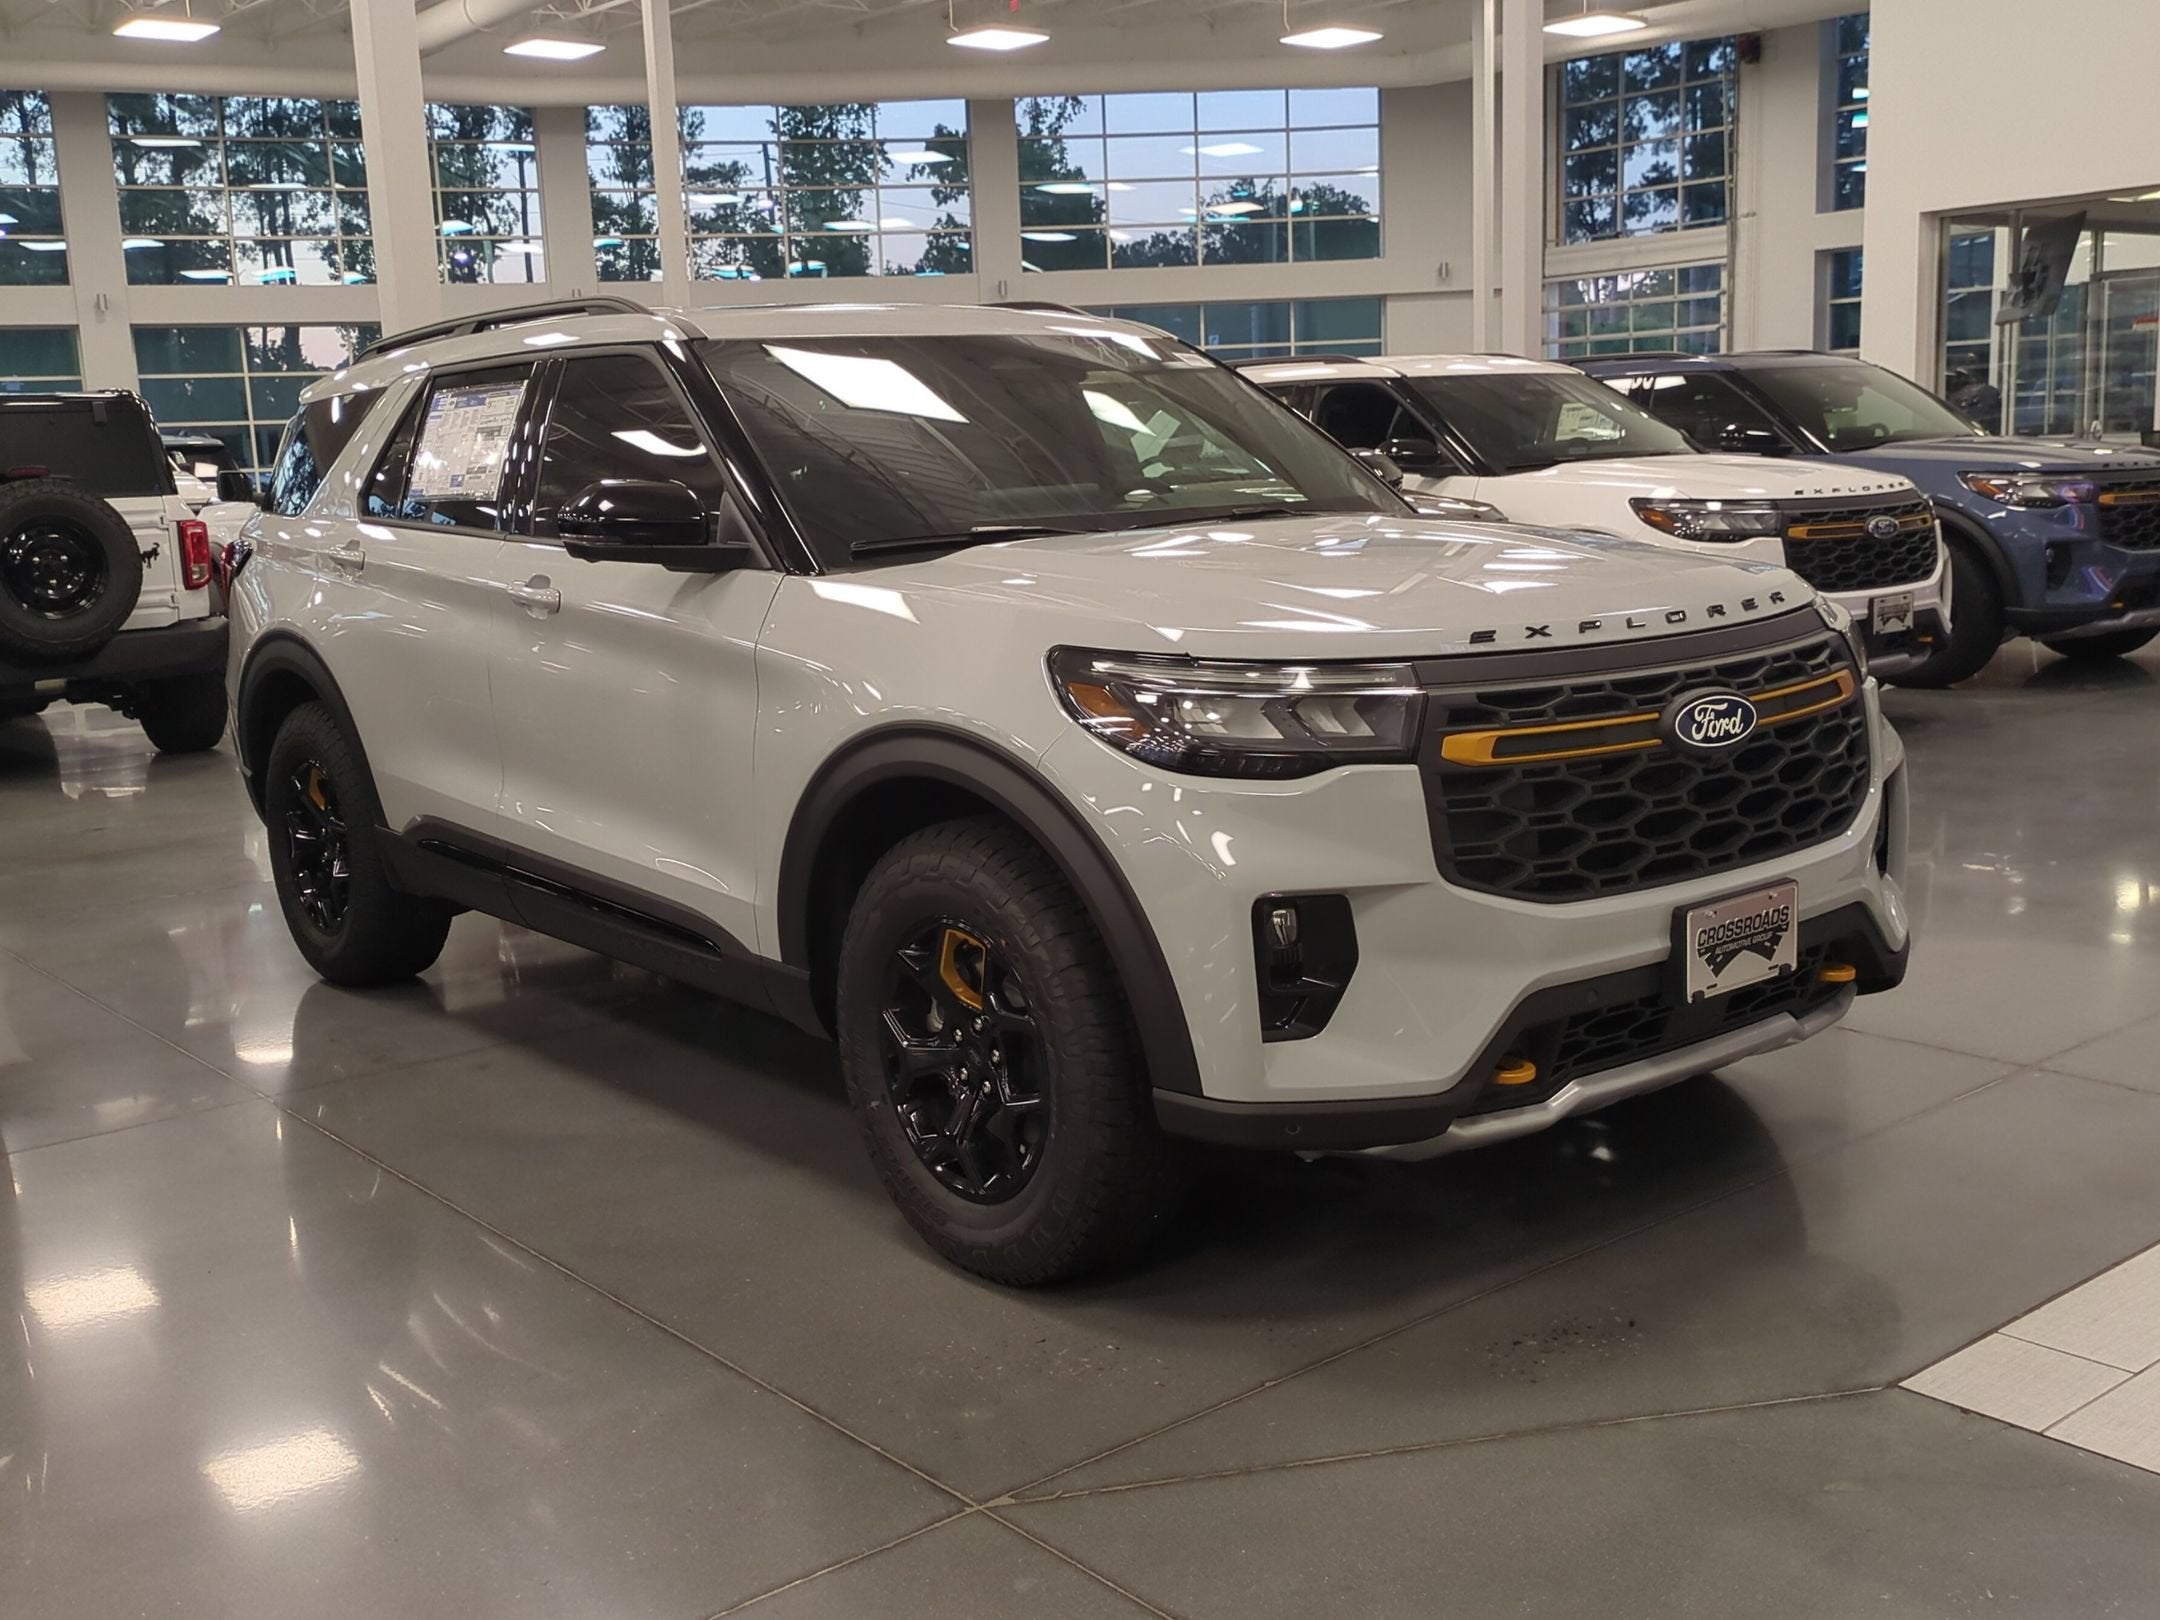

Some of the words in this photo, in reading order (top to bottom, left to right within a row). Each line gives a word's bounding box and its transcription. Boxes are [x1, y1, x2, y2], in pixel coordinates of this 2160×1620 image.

[1469, 590, 1786, 645] EXPLORER
[1691, 702, 1744, 740] Ford
[1697, 905, 1790, 948] CROSSROADS
